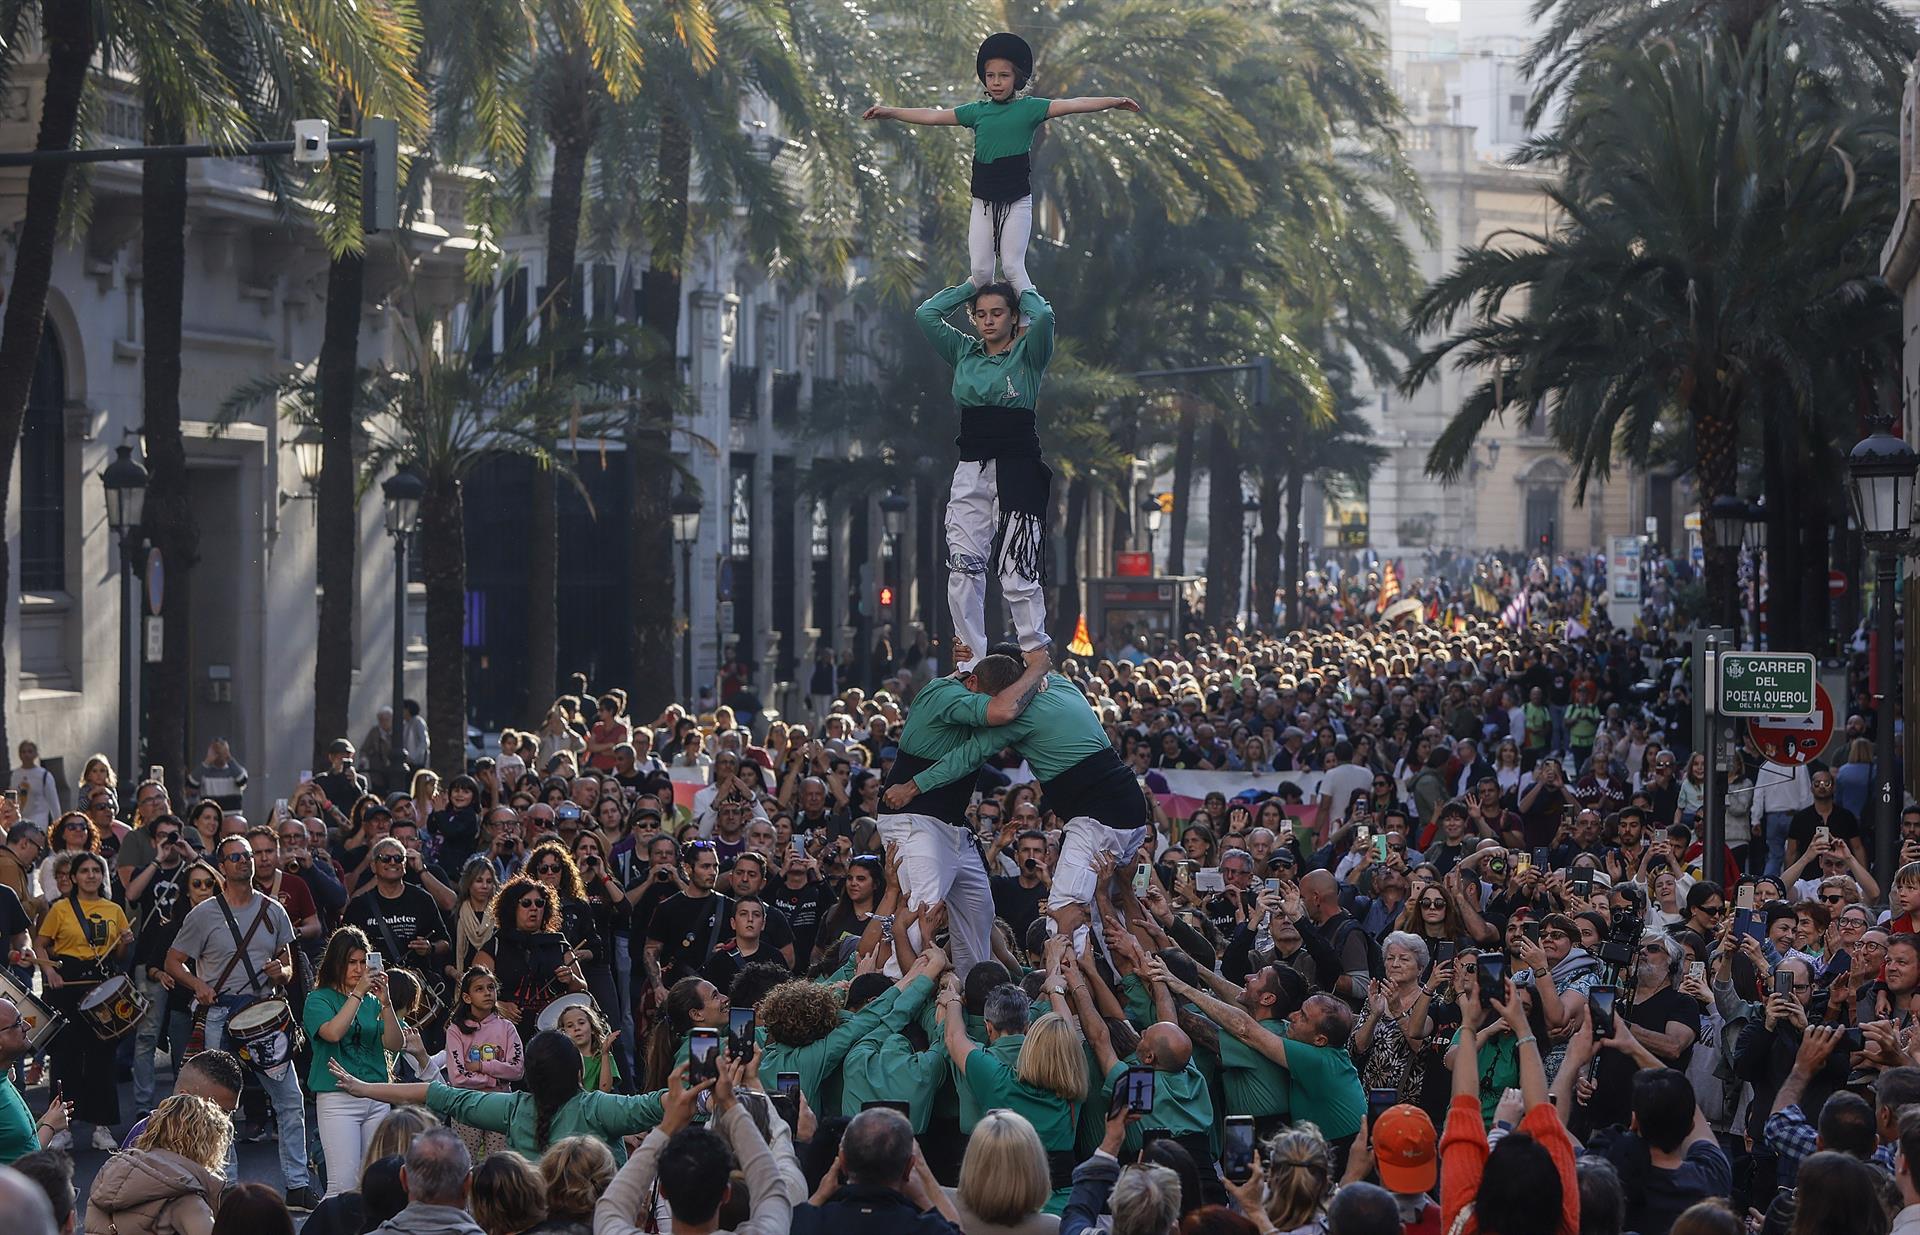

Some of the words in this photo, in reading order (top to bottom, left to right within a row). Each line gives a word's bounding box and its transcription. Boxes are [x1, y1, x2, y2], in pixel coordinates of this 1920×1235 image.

[1748, 661, 1806, 673] CARRER
[1755, 676, 1778, 687] DEL
[1726, 690, 1761, 702] POETA
[1764, 691, 1808, 703] QUEROL
